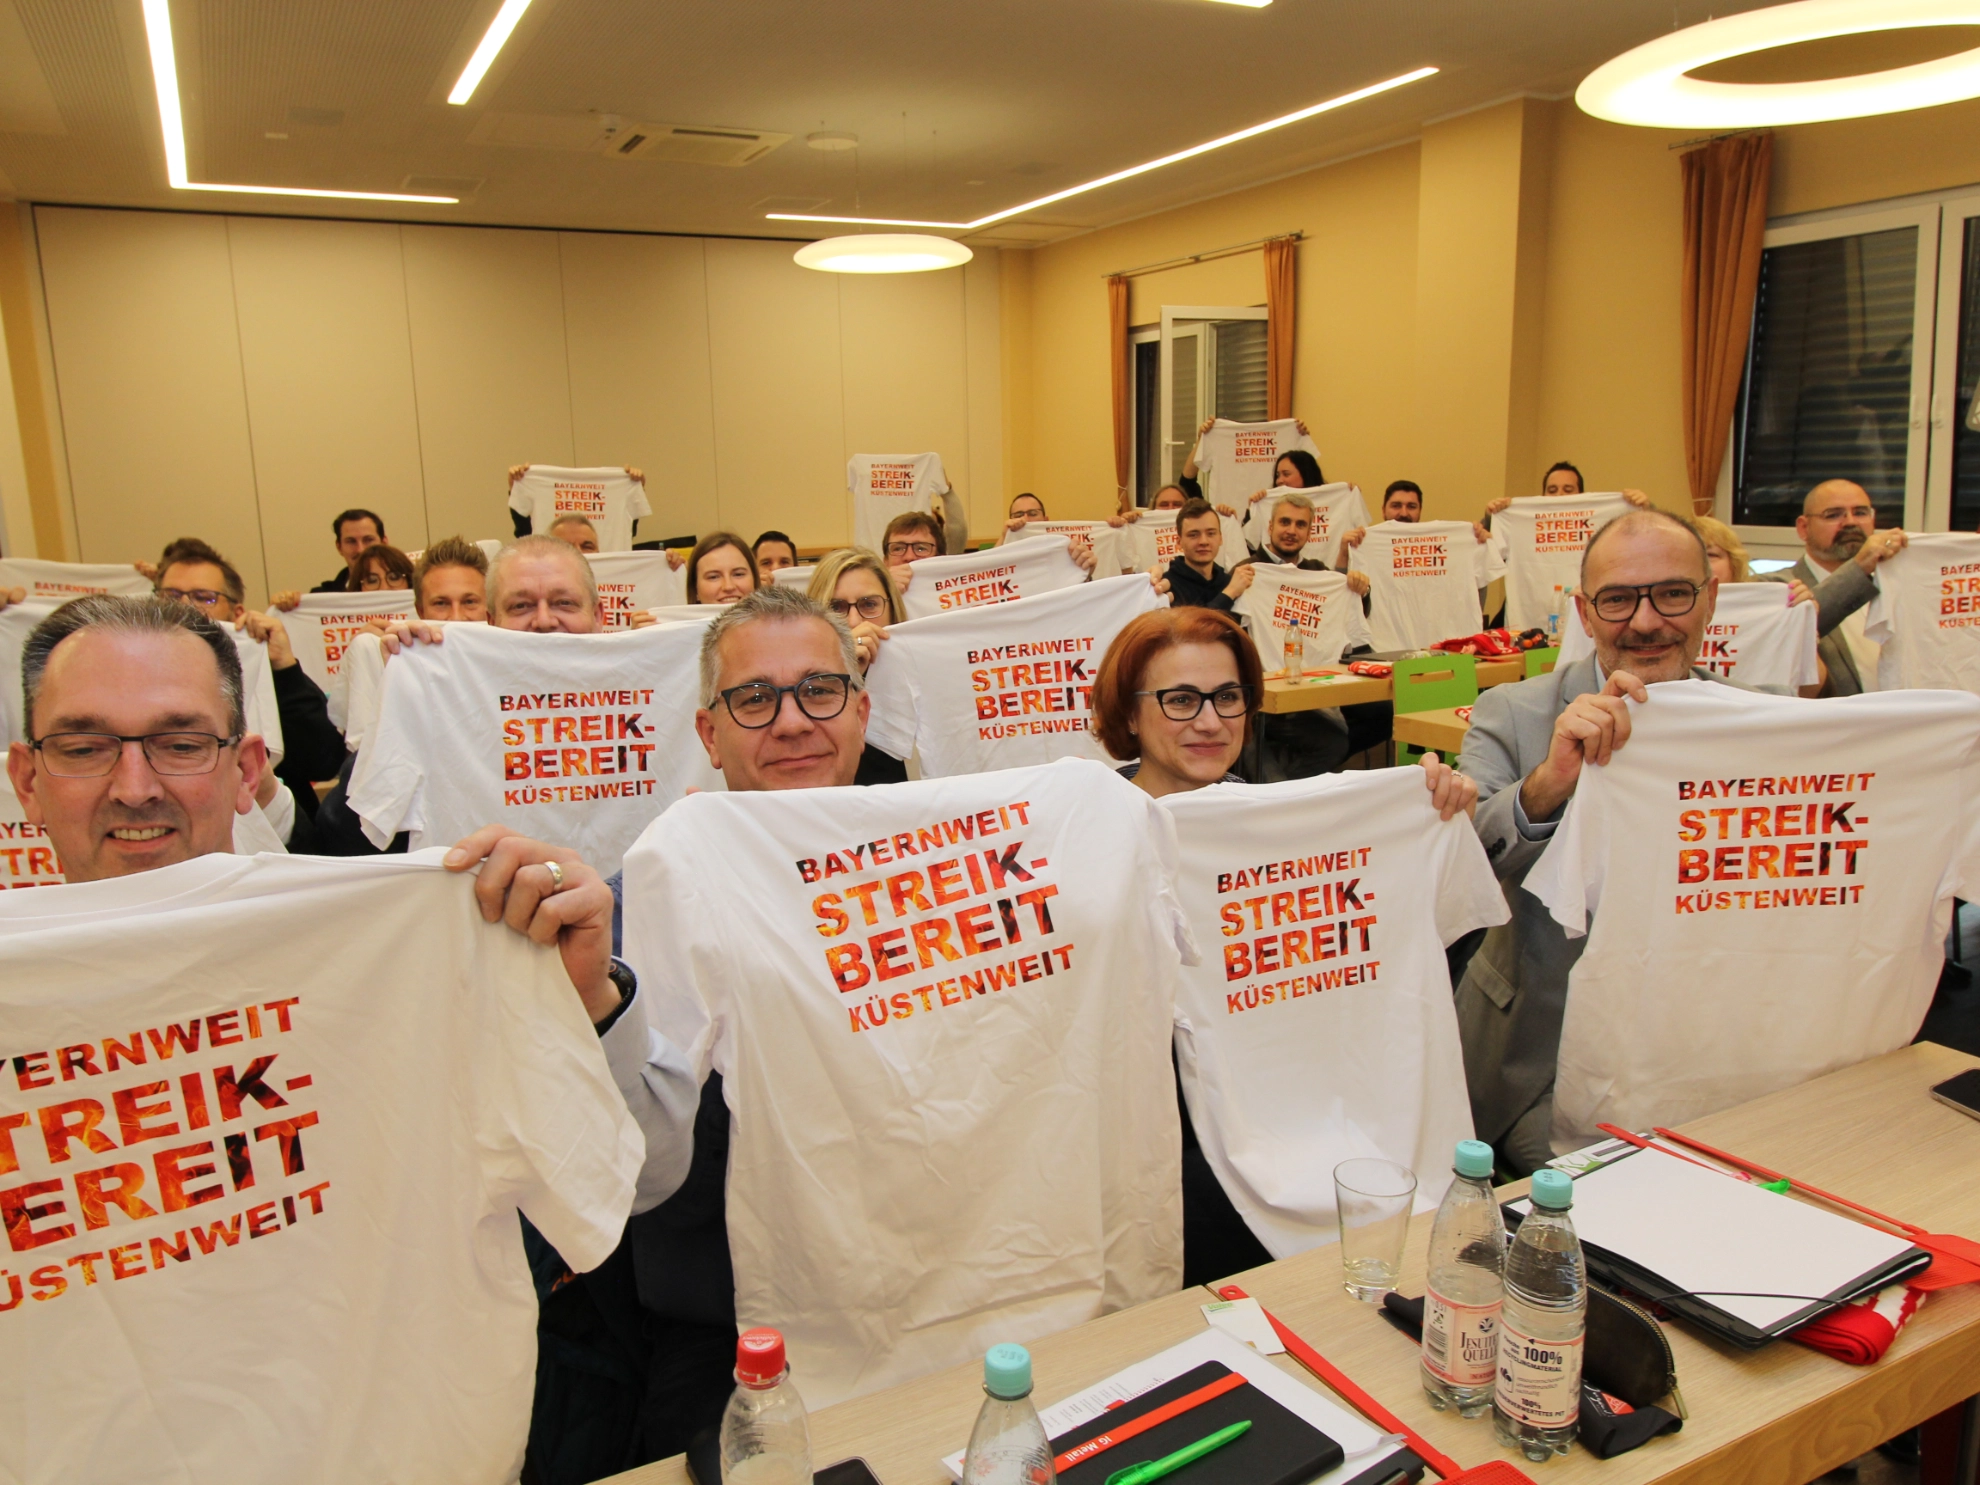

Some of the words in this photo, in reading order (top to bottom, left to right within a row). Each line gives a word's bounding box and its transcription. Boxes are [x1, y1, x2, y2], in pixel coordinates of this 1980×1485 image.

[1235, 438, 1278, 447] STREIK-
[1235, 447, 1277, 456] BEREIT
[871, 470, 915, 479] STREIK-
[871, 480, 915, 489] BEREIT
[555, 490, 606, 501] STREIK-
[555, 501, 606, 511] BEREIT
[1535, 510, 1594, 519] BAYERNWEIT
[1535, 519, 1595, 531] STREIK-
[1392, 536, 1447, 544] BAYERNWEIT
[1535, 531, 1595, 544] BEREIT
[1157, 545, 1183, 556] BER
[1393, 545, 1448, 556] STREIK-
[1393, 556, 1447, 568] BEREIT
[934, 565, 1016, 591] BAYERNWEIT
[1941, 564, 1980, 576] BAYER
[34, 582, 108, 595] BAYERNWEIT
[598, 584, 635, 592] NWEIT
[939, 579, 1019, 610] STREIK-
[1280, 584, 1327, 602] BAYERNWEIT
[600, 596, 635, 609] EIK-
[1276, 594, 1323, 615] STREIK-
[1940, 596, 1980, 614] BER
[603, 612, 633, 626] EIT
[1274, 606, 1322, 628] BEREIT
[967, 637, 1094, 664] BAYERNWEIT
[971, 658, 1097, 692] STREIK-
[500, 689, 655, 712] BAYERNWEIT
[975, 685, 1093, 720] BEREIT
[502, 713, 655, 746] STREIK-
[978, 717, 1095, 740] KÜSTENWEI
[504, 743, 656, 781] BEREIT
[504, 779, 656, 806] KÜSTENWEIT
[1678, 773, 1876, 800] BAYERNWEIT
[1677, 802, 1869, 842] STREIK-
[796, 801, 1031, 884] BAYERNWEIT
[1217, 847, 1372, 894] BAYERNWEIT
[1678, 840, 1869, 884] BEREIT
[811, 841, 1049, 938] STREIK-
[1675, 884, 1865, 914] KÜSTENWEIT
[1219, 878, 1375, 937] STREIK-
[824, 884, 1059, 993] BEREIT
[1223, 915, 1377, 982] BEREIT
[848, 943, 1075, 1033] KÜSTENWEIT
[1226, 961, 1380, 1015] KÜSTENWEIT
[0, 997, 299, 1091] ERNWEIT
[0, 1053, 313, 1175] TREIK-
[0, 1110, 319, 1252] EREIT
[0, 1180, 330, 1312] ÜSTENWEIT
[1523, 1346, 1563, 1365] 100%
[1064, 1441, 1099, 1462] Metall
[1098, 1435, 1113, 1446] IG
